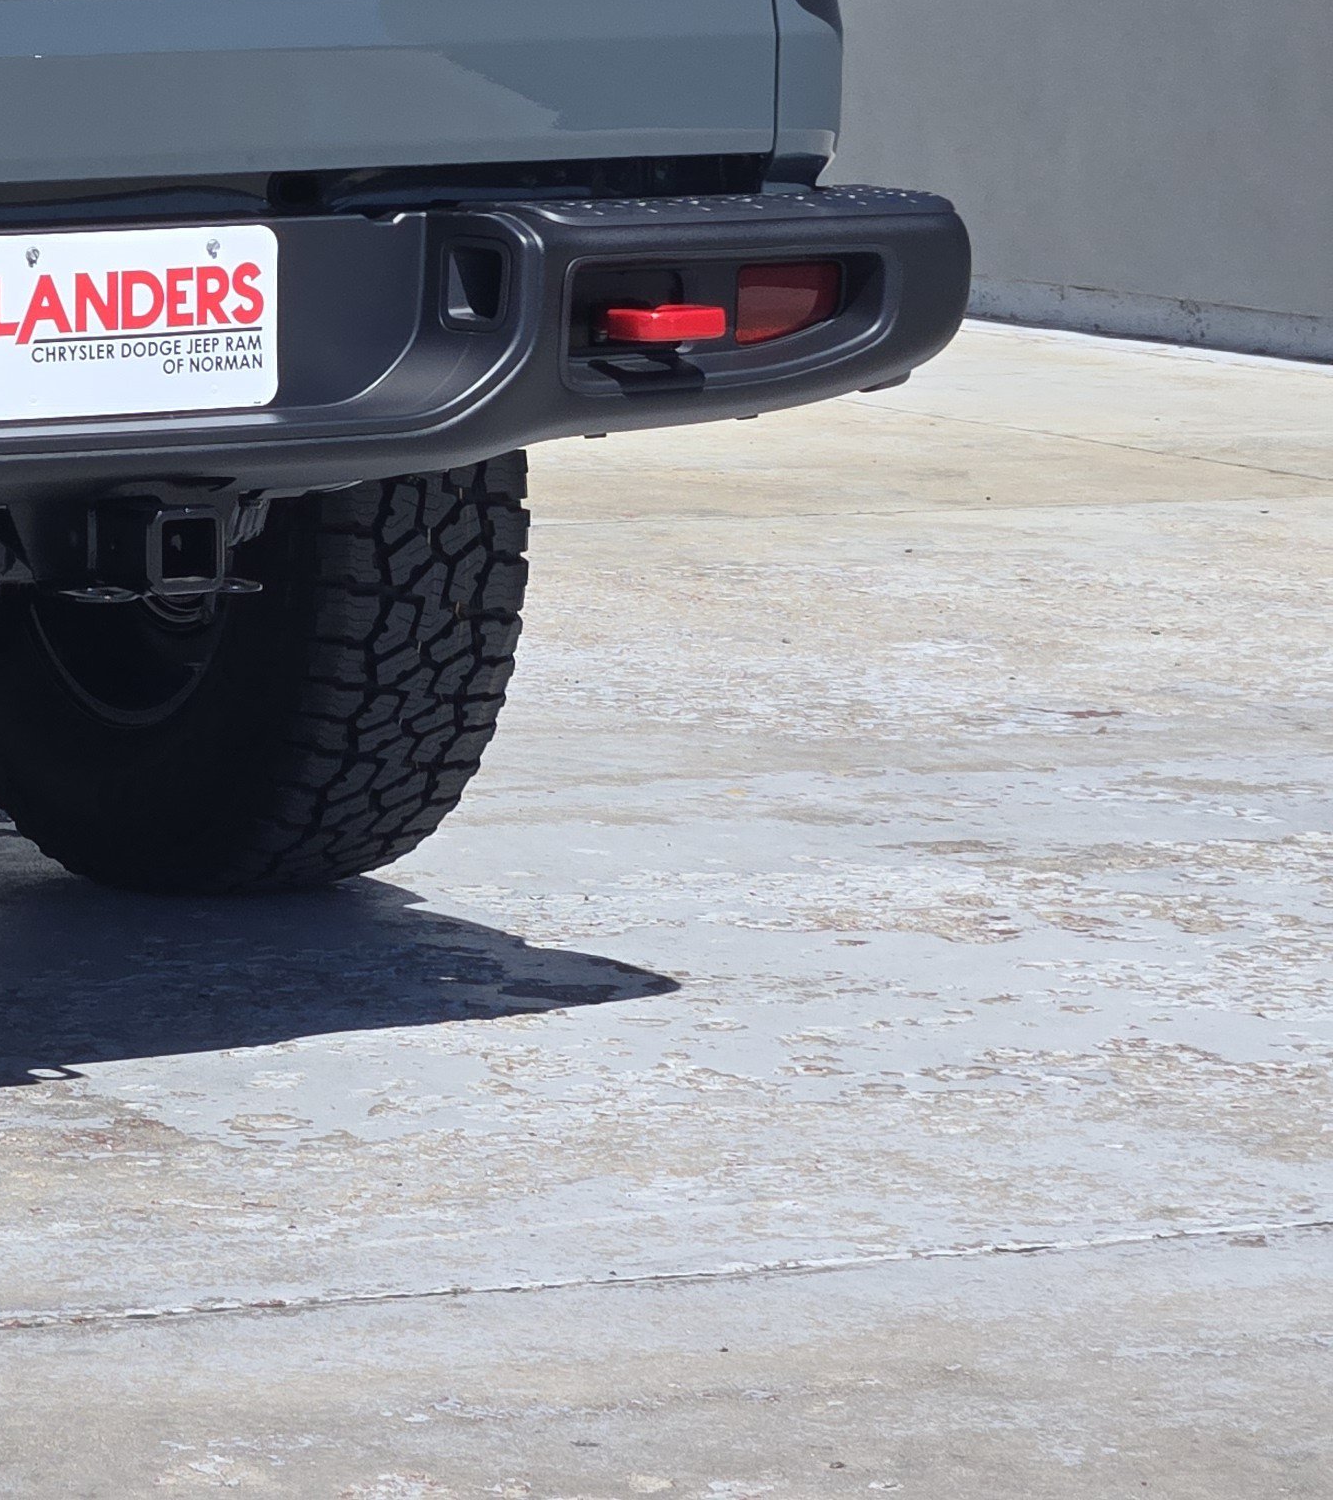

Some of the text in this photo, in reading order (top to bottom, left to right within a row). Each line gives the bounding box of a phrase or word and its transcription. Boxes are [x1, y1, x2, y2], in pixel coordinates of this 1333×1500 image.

[31, 335, 263, 363] CHRYSLER DODGE JEEP RAM
[162, 353, 263, 375] OF NORMAN
